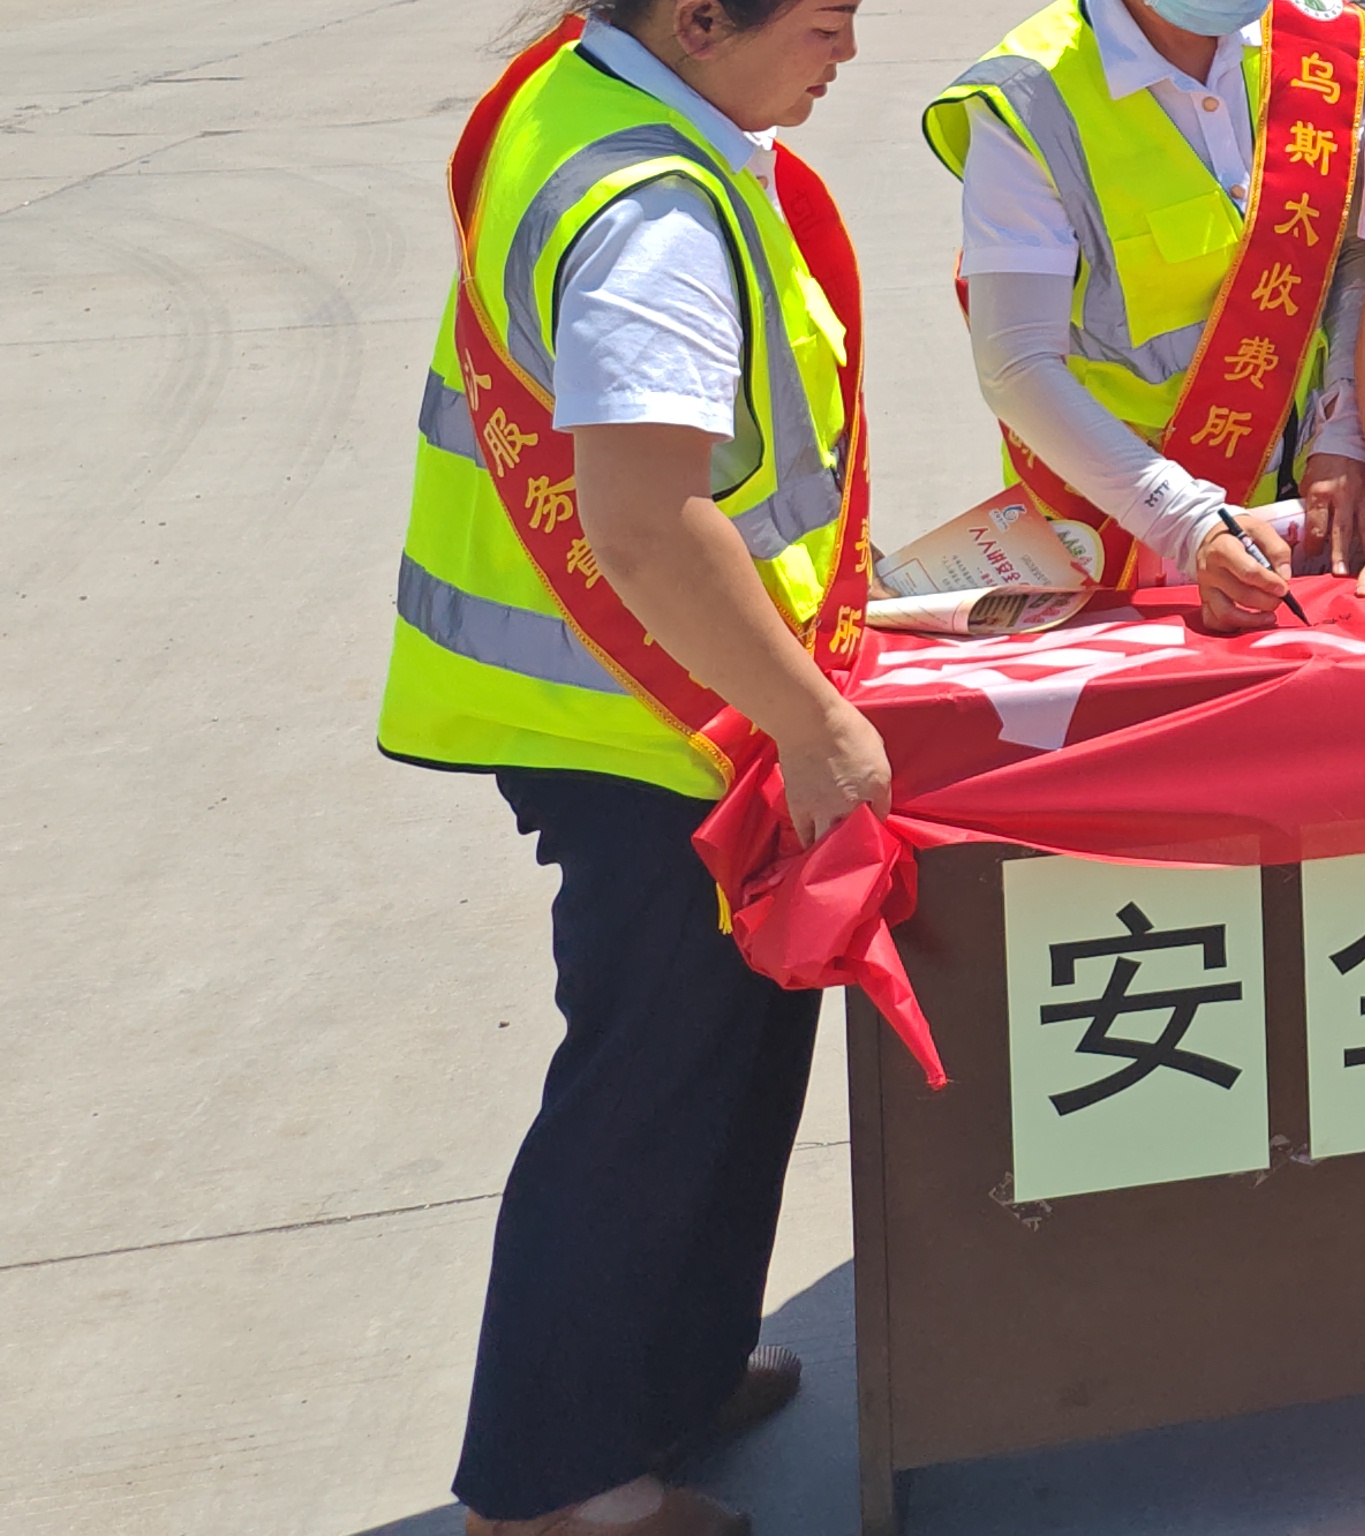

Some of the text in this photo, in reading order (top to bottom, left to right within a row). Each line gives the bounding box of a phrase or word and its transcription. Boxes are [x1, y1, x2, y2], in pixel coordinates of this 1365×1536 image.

[1190, 54, 1342, 460] 乌斯太收费所
